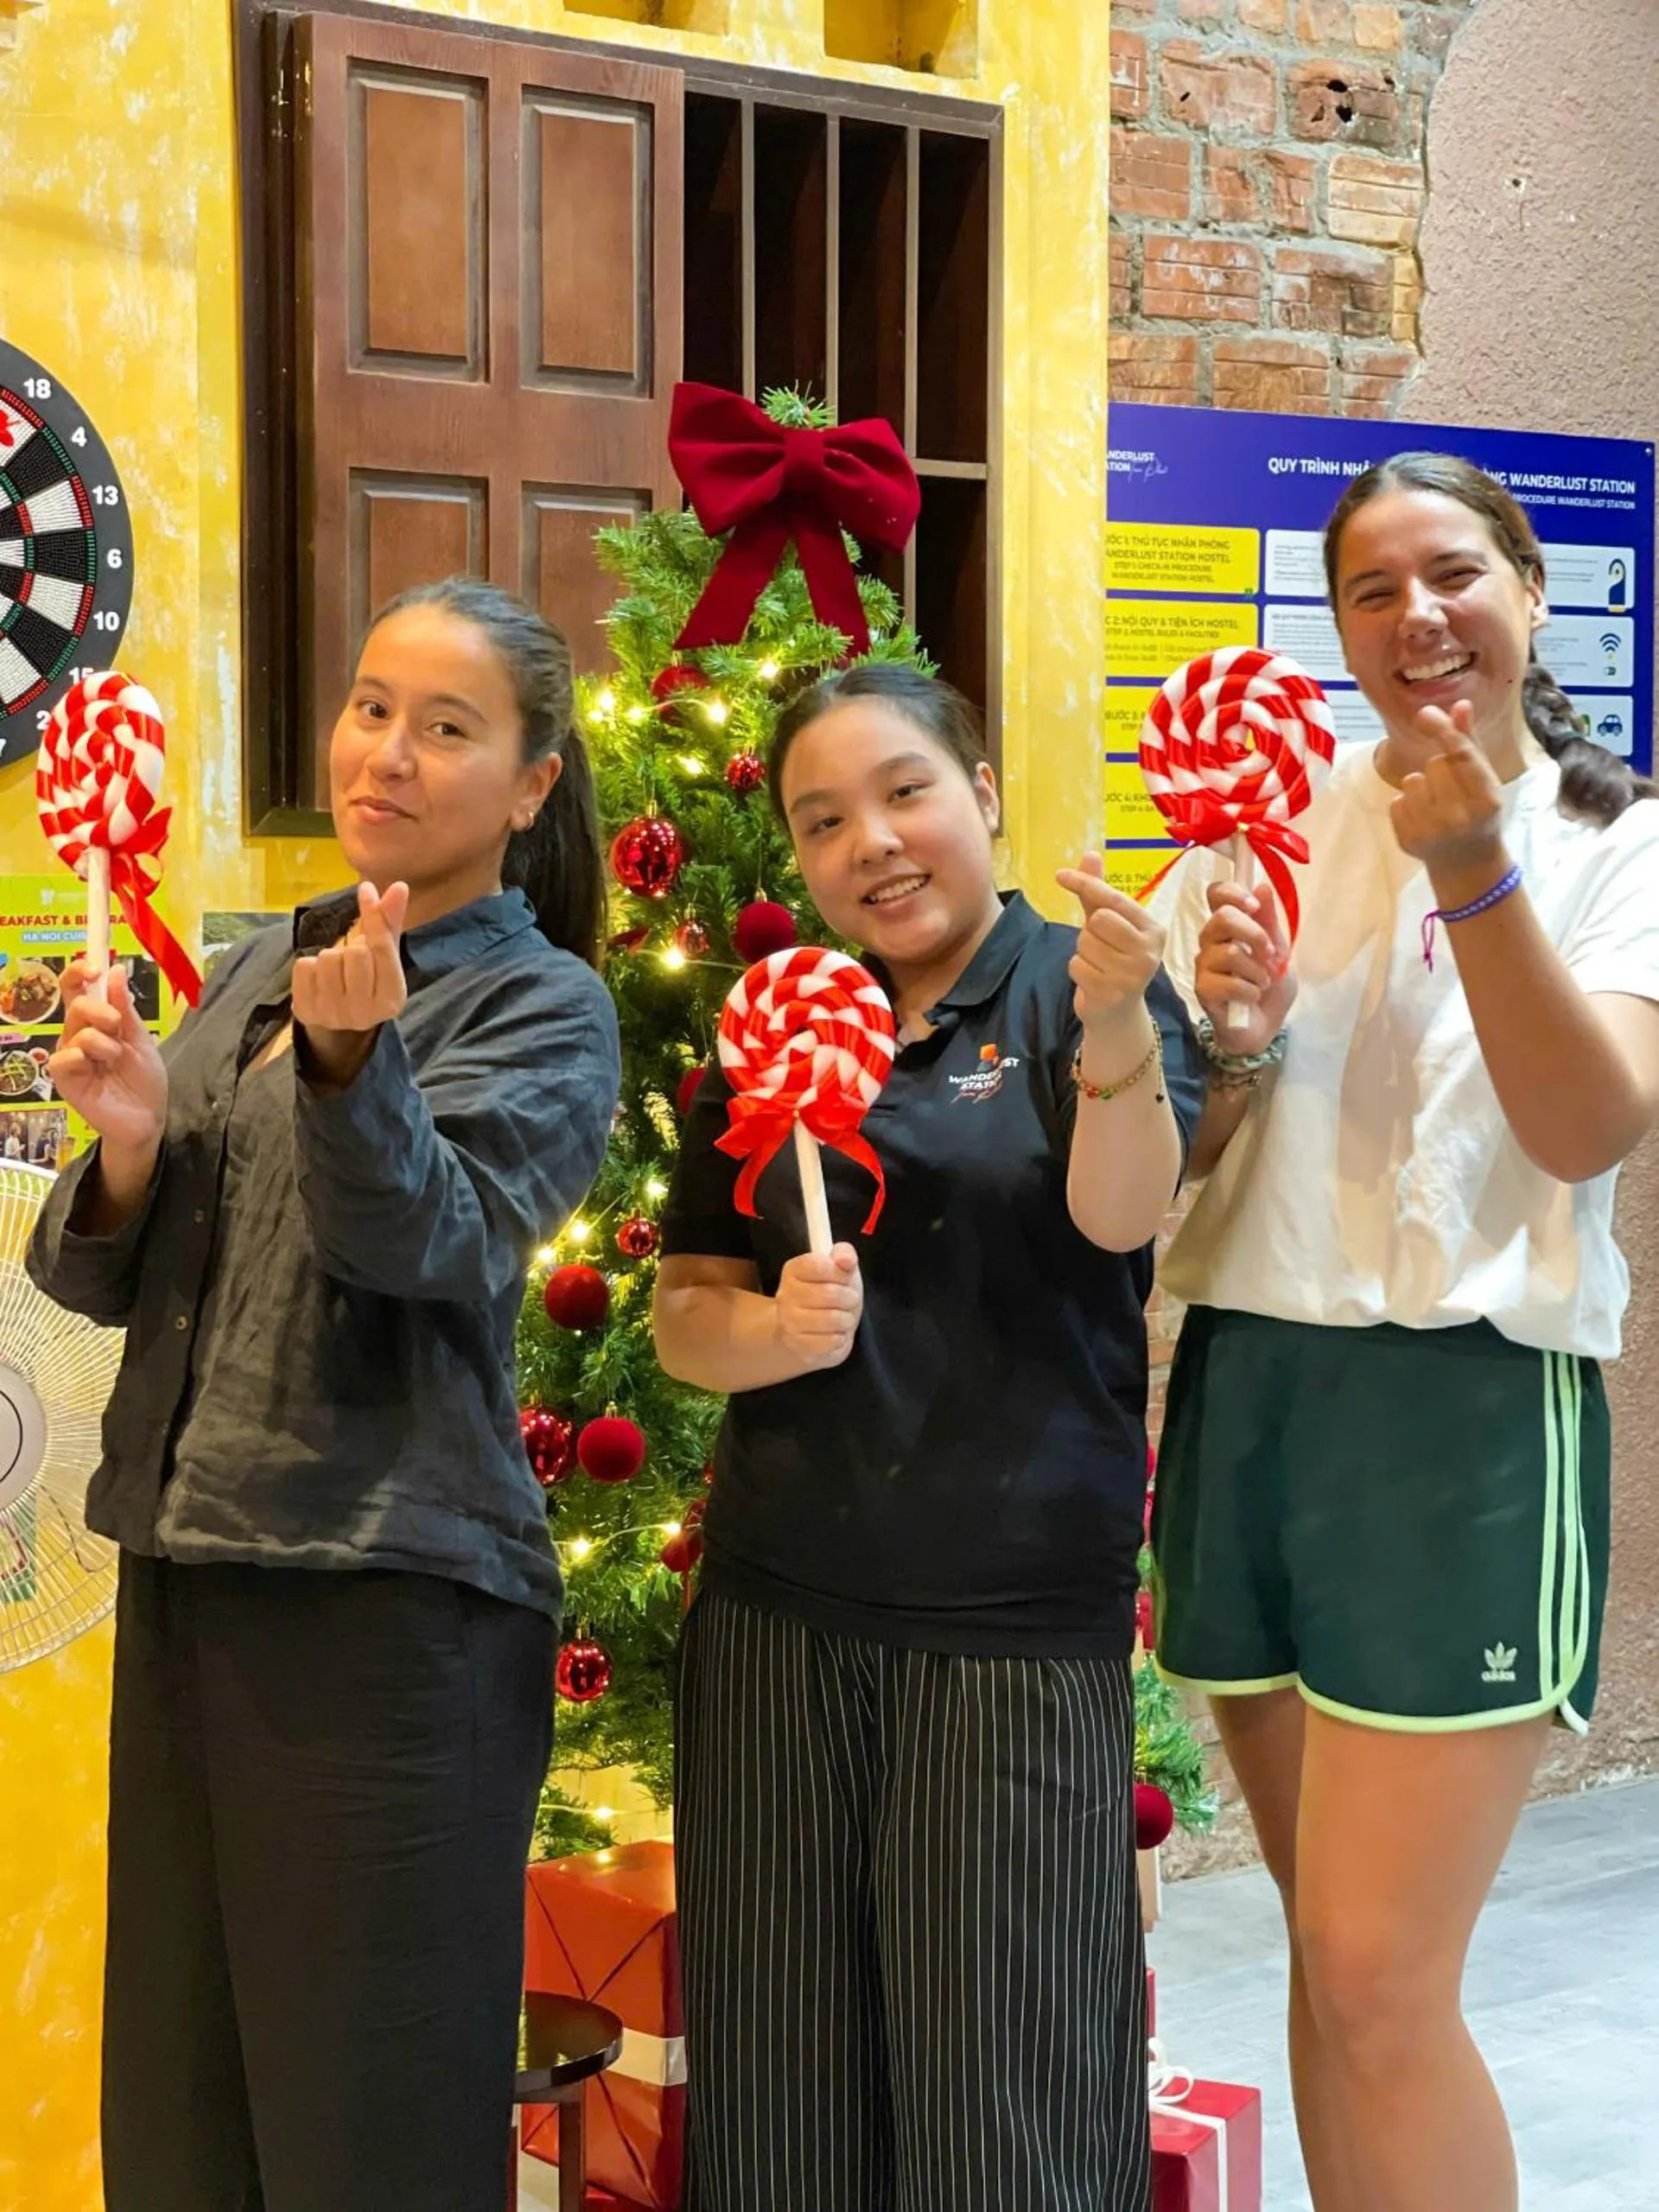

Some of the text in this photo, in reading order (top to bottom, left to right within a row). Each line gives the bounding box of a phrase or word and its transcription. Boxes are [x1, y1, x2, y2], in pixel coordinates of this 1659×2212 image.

[23, 378, 51, 399] 18
[72, 427, 86, 447] 4
[1107, 450, 1155, 461] NDERLUST
[1106, 461, 1130, 472] TION
[1268, 457, 1297, 474] QUY
[1299, 456, 1339, 475] TRÌNH
[1510, 473, 1586, 491] WANDERLUST
[1589, 478, 1635, 494] STATION
[92, 485, 118, 505] 13
[1558, 496, 1605, 508] WANDERLUST
[1606, 499, 1635, 510] STATION
[107, 549, 122, 569] 6
[1159, 550, 1195, 561] STATION
[1198, 553, 1230, 563] HOSTEL
[93, 612, 119, 631] 10
